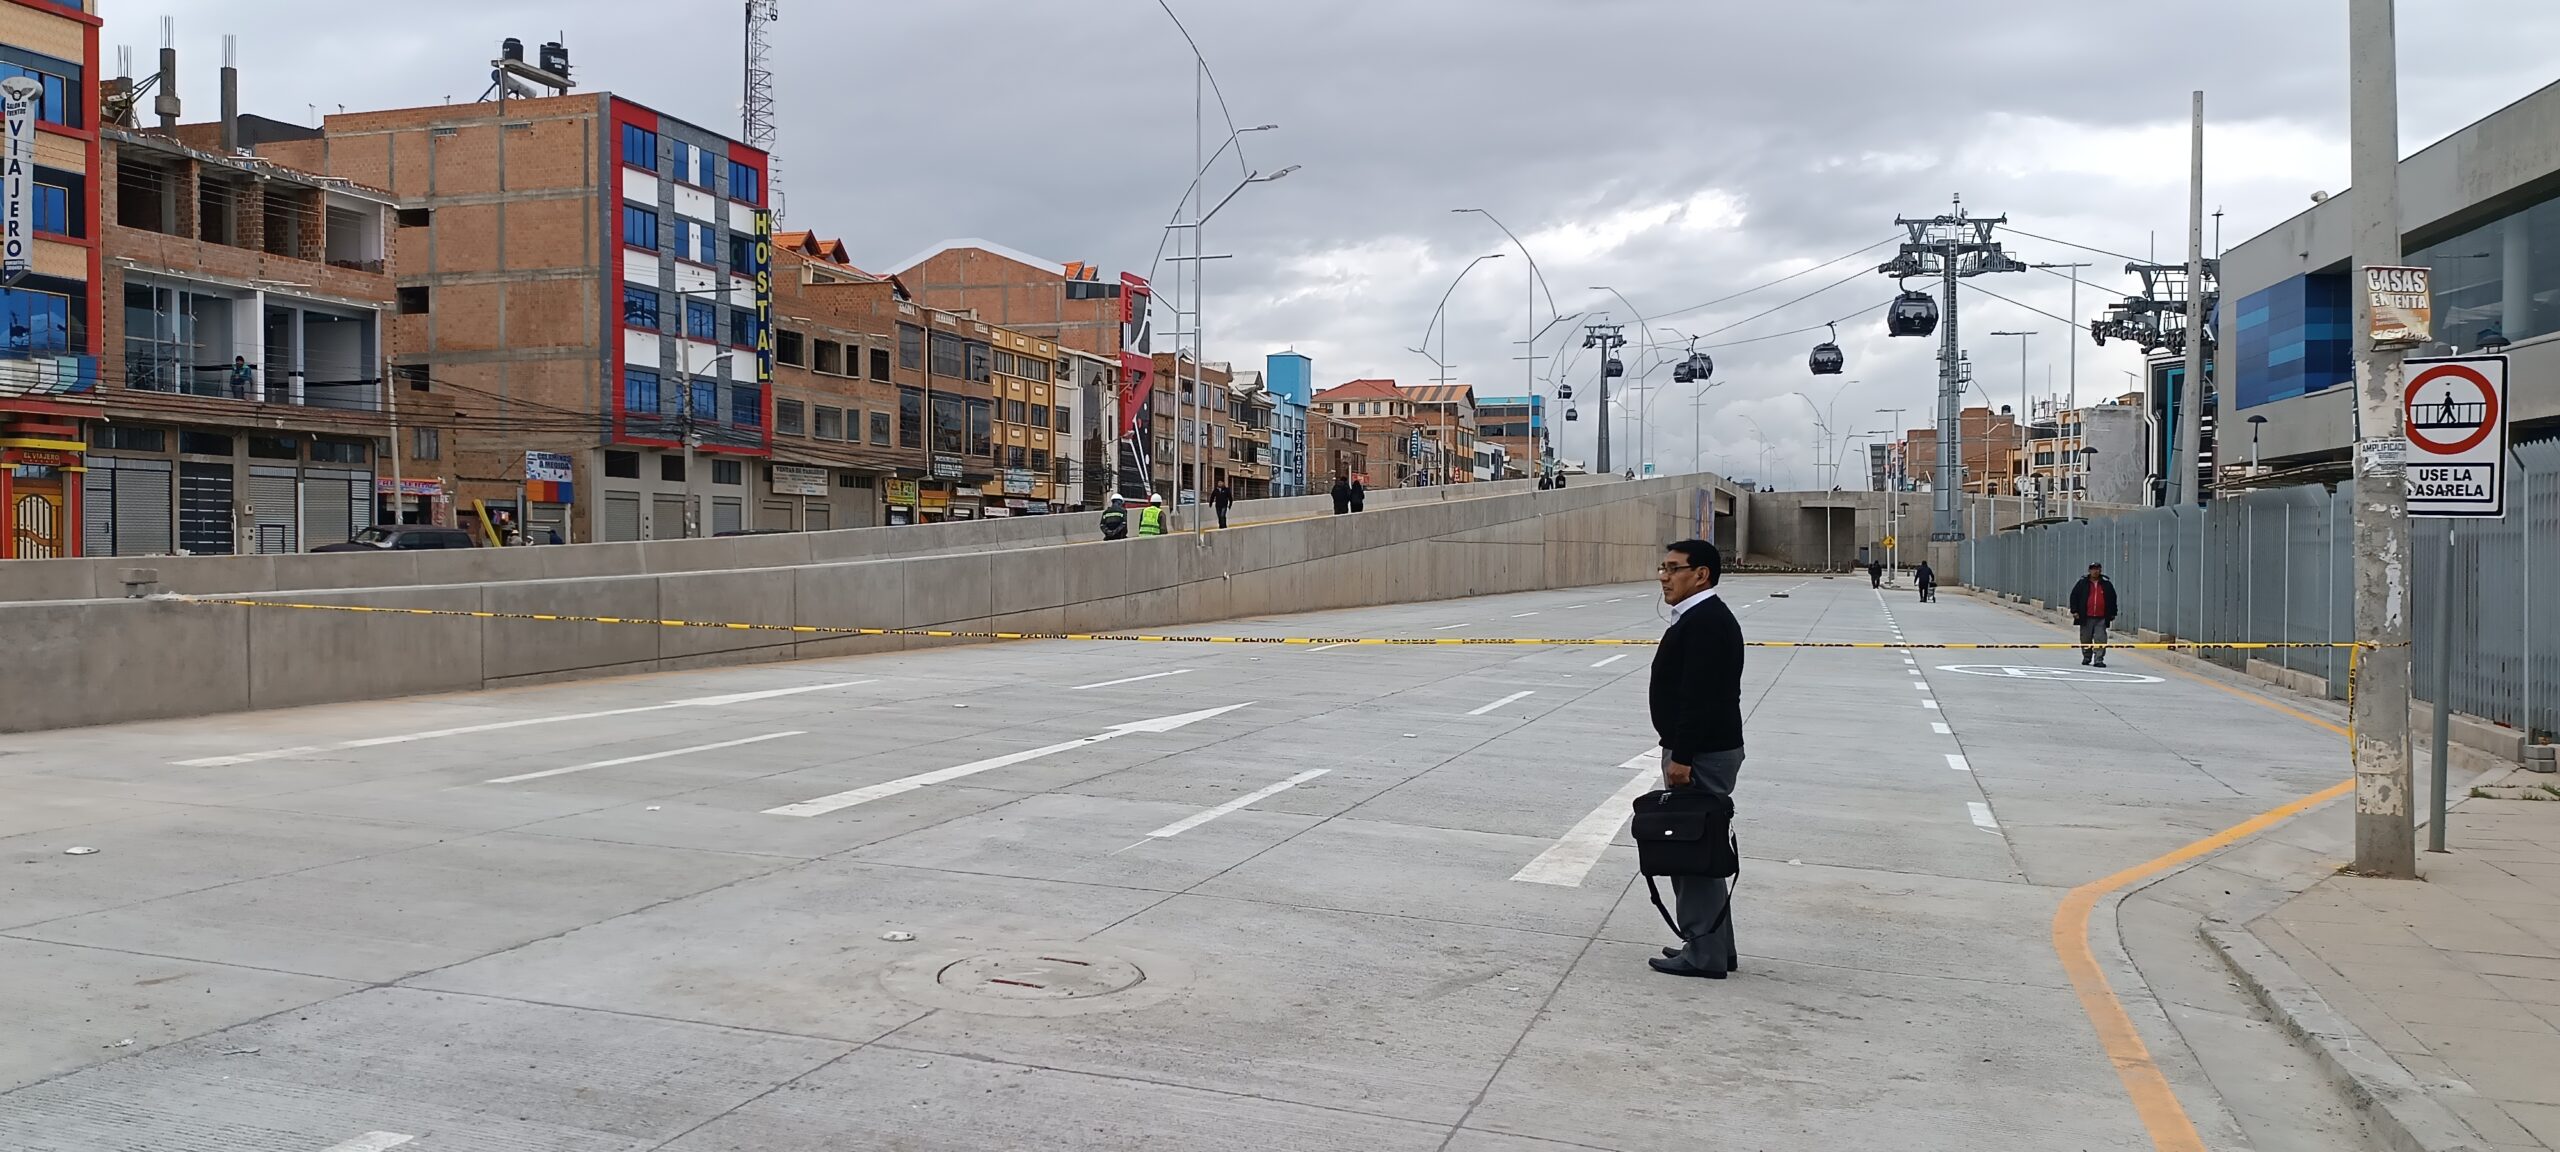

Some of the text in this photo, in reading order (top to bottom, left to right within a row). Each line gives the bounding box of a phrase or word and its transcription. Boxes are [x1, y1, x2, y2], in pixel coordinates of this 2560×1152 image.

[6, 119, 24, 258] VIAJERO
[2367, 269, 2426, 293] CASAS
[755, 212, 769, 381] HOSTAL
[23, 451, 61, 461] EL VIAJERO
[539, 460, 571, 470] A MEDIDA
[2419, 469, 2473, 481] USE LA
